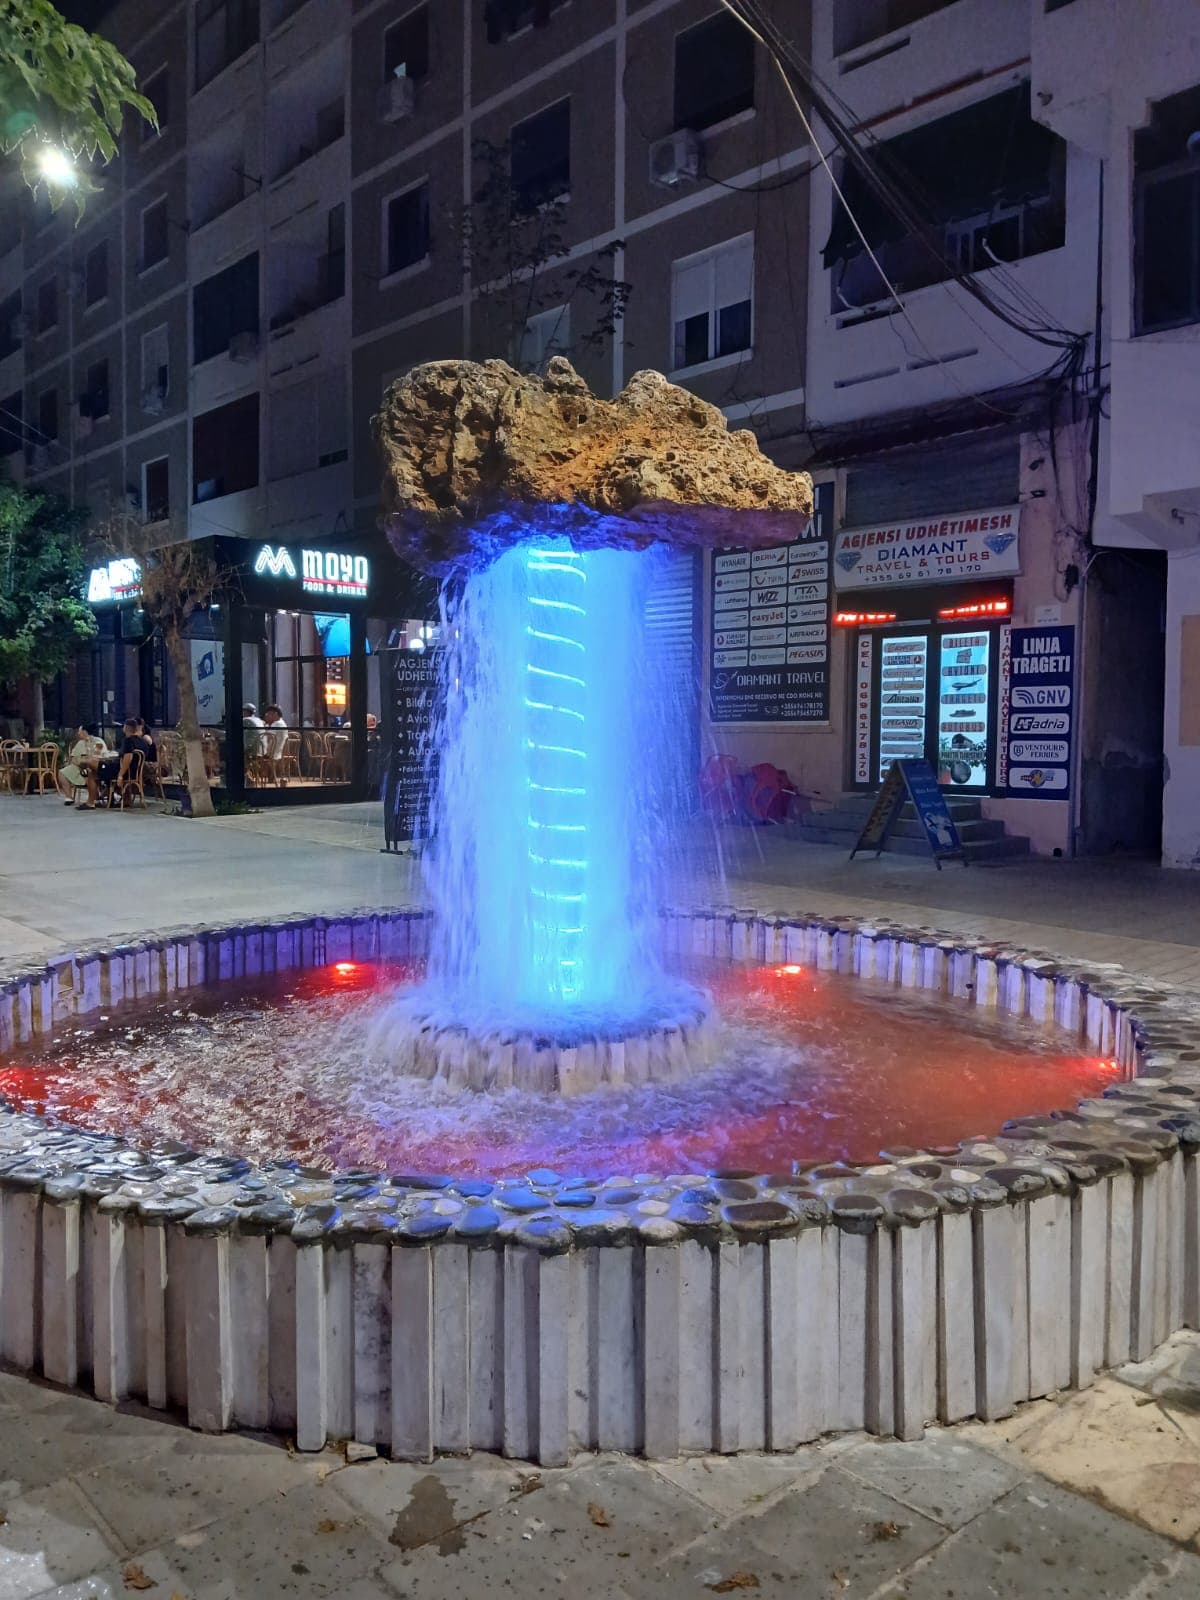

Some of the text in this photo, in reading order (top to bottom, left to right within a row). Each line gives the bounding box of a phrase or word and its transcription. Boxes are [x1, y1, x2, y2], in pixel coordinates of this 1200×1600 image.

[841, 529, 900, 549] AGJENSI
[877, 539, 968, 562] DIAMANT
[857, 551, 990, 575] TRAVEL & TOURS
[801, 567, 825, 577] SWISS
[864, 574, 893, 583] +355
[959, 564, 981, 574] 170
[303, 581, 324, 593] FOOD
[326, 583, 335, 593] &
[751, 611, 784, 623] easyJet
[788, 649, 825, 659] PEGASUS
[1022, 636, 1061, 655] LINJA
[860, 641, 870, 668] CEL
[1011, 655, 1071, 674] TRAGETI
[736, 671, 826, 687] DIAMANT TRAVEL
[1036, 689, 1067, 705] GNV
[1031, 717, 1065, 729] adria
